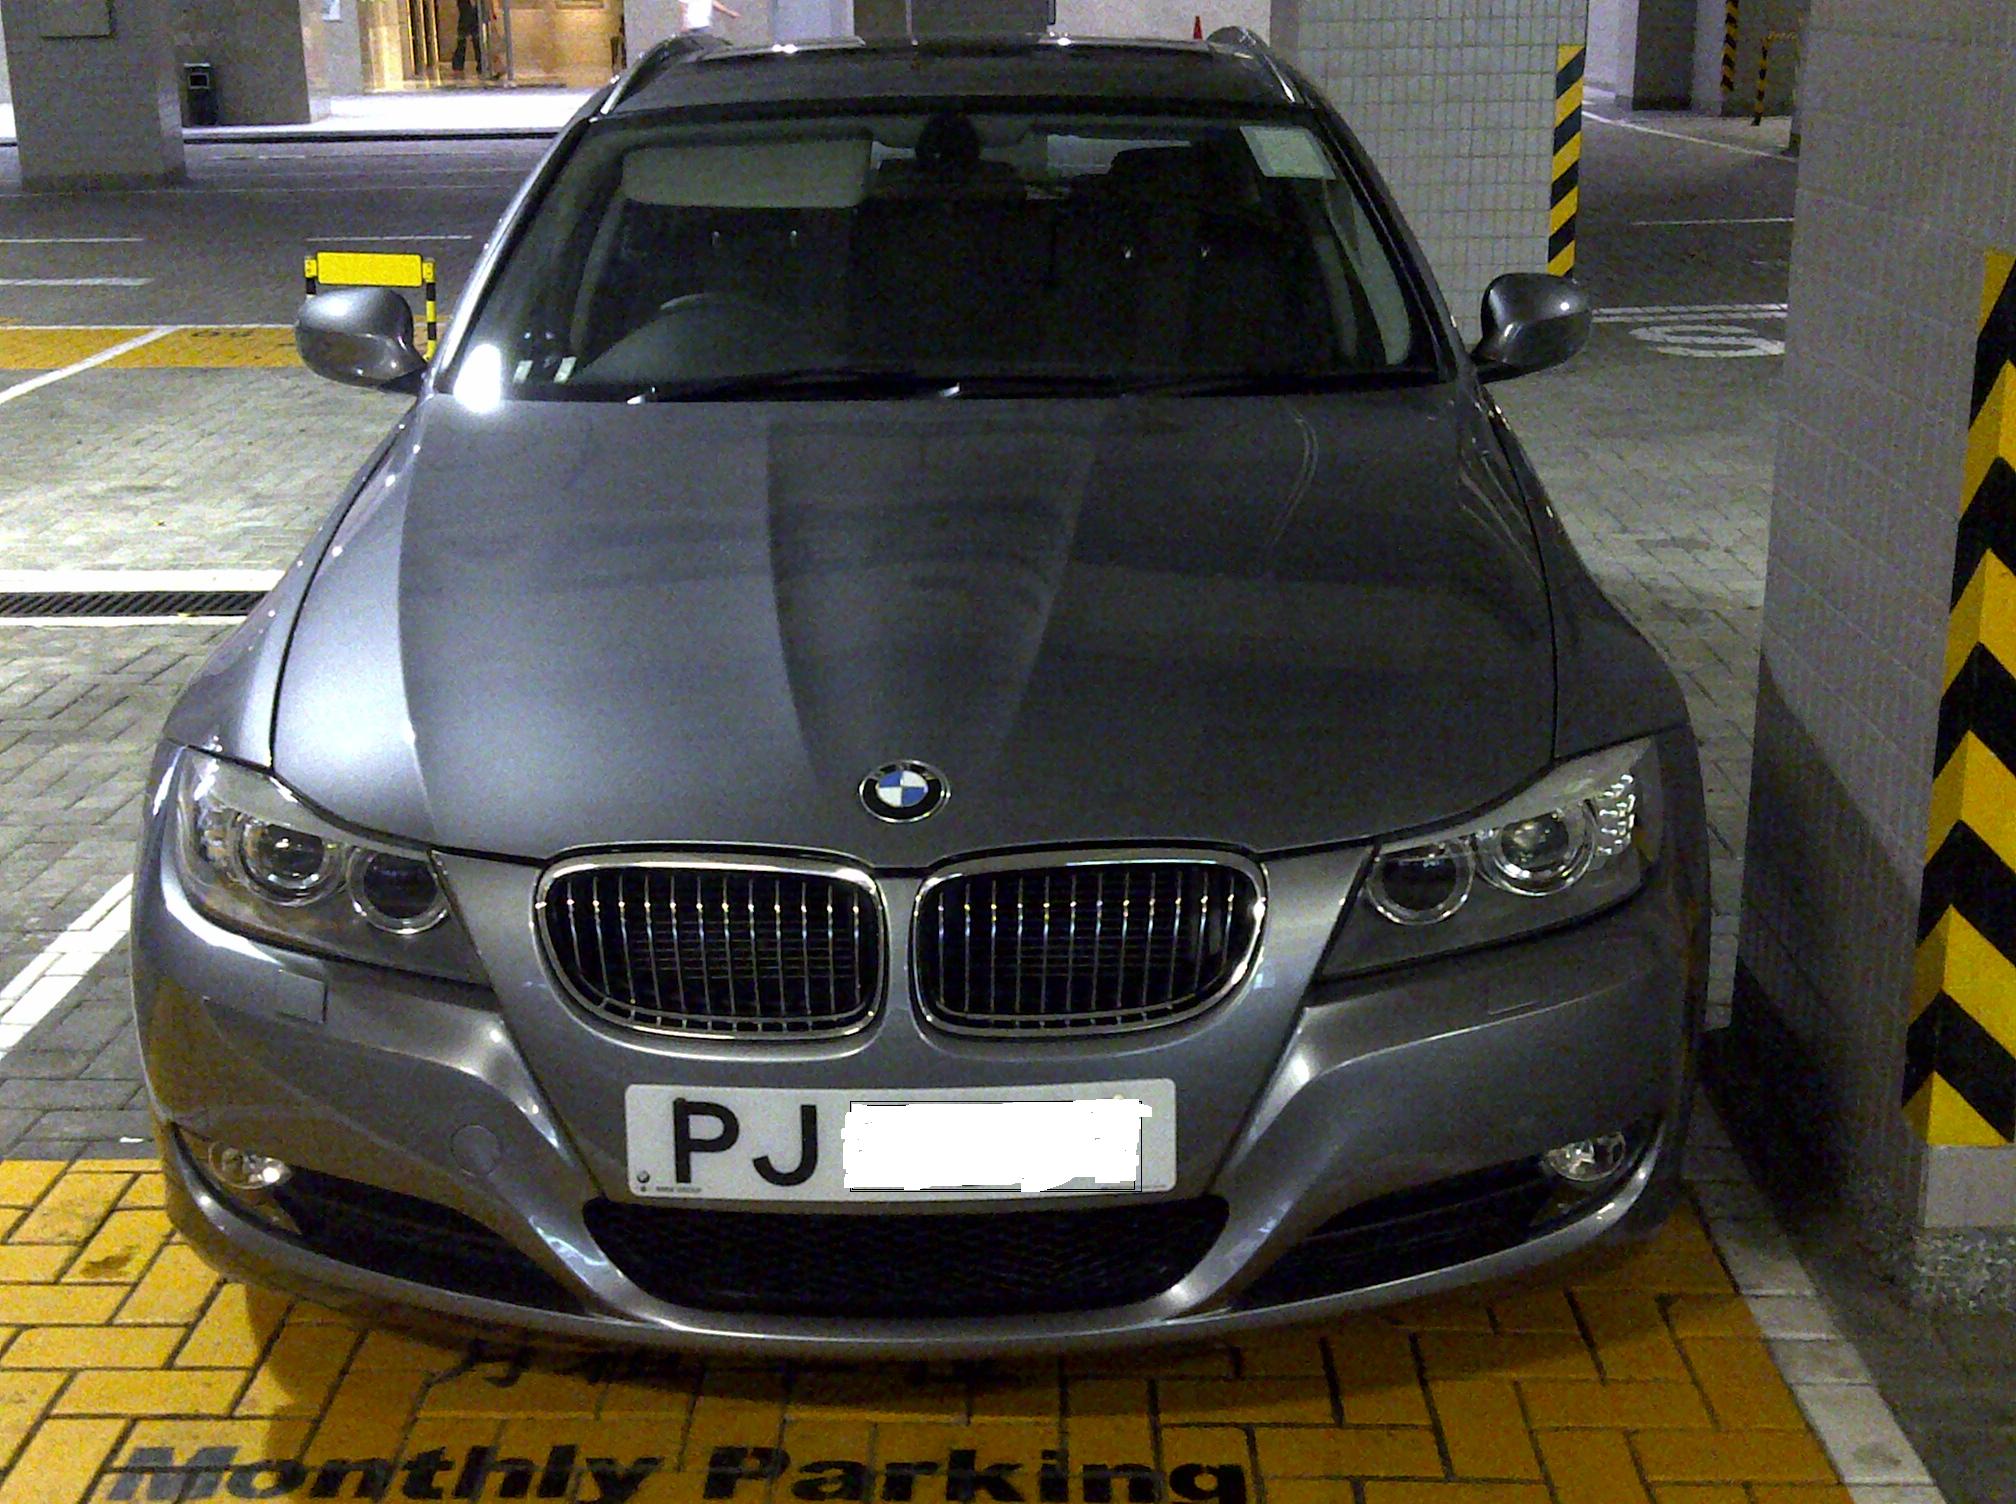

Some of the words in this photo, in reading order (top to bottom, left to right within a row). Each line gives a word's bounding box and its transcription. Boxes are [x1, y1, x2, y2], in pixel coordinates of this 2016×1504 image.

[673, 1098, 819, 1187] PJ
[106, 1444, 666, 1504] Monthly
[702, 1446, 1246, 1504] Parking
